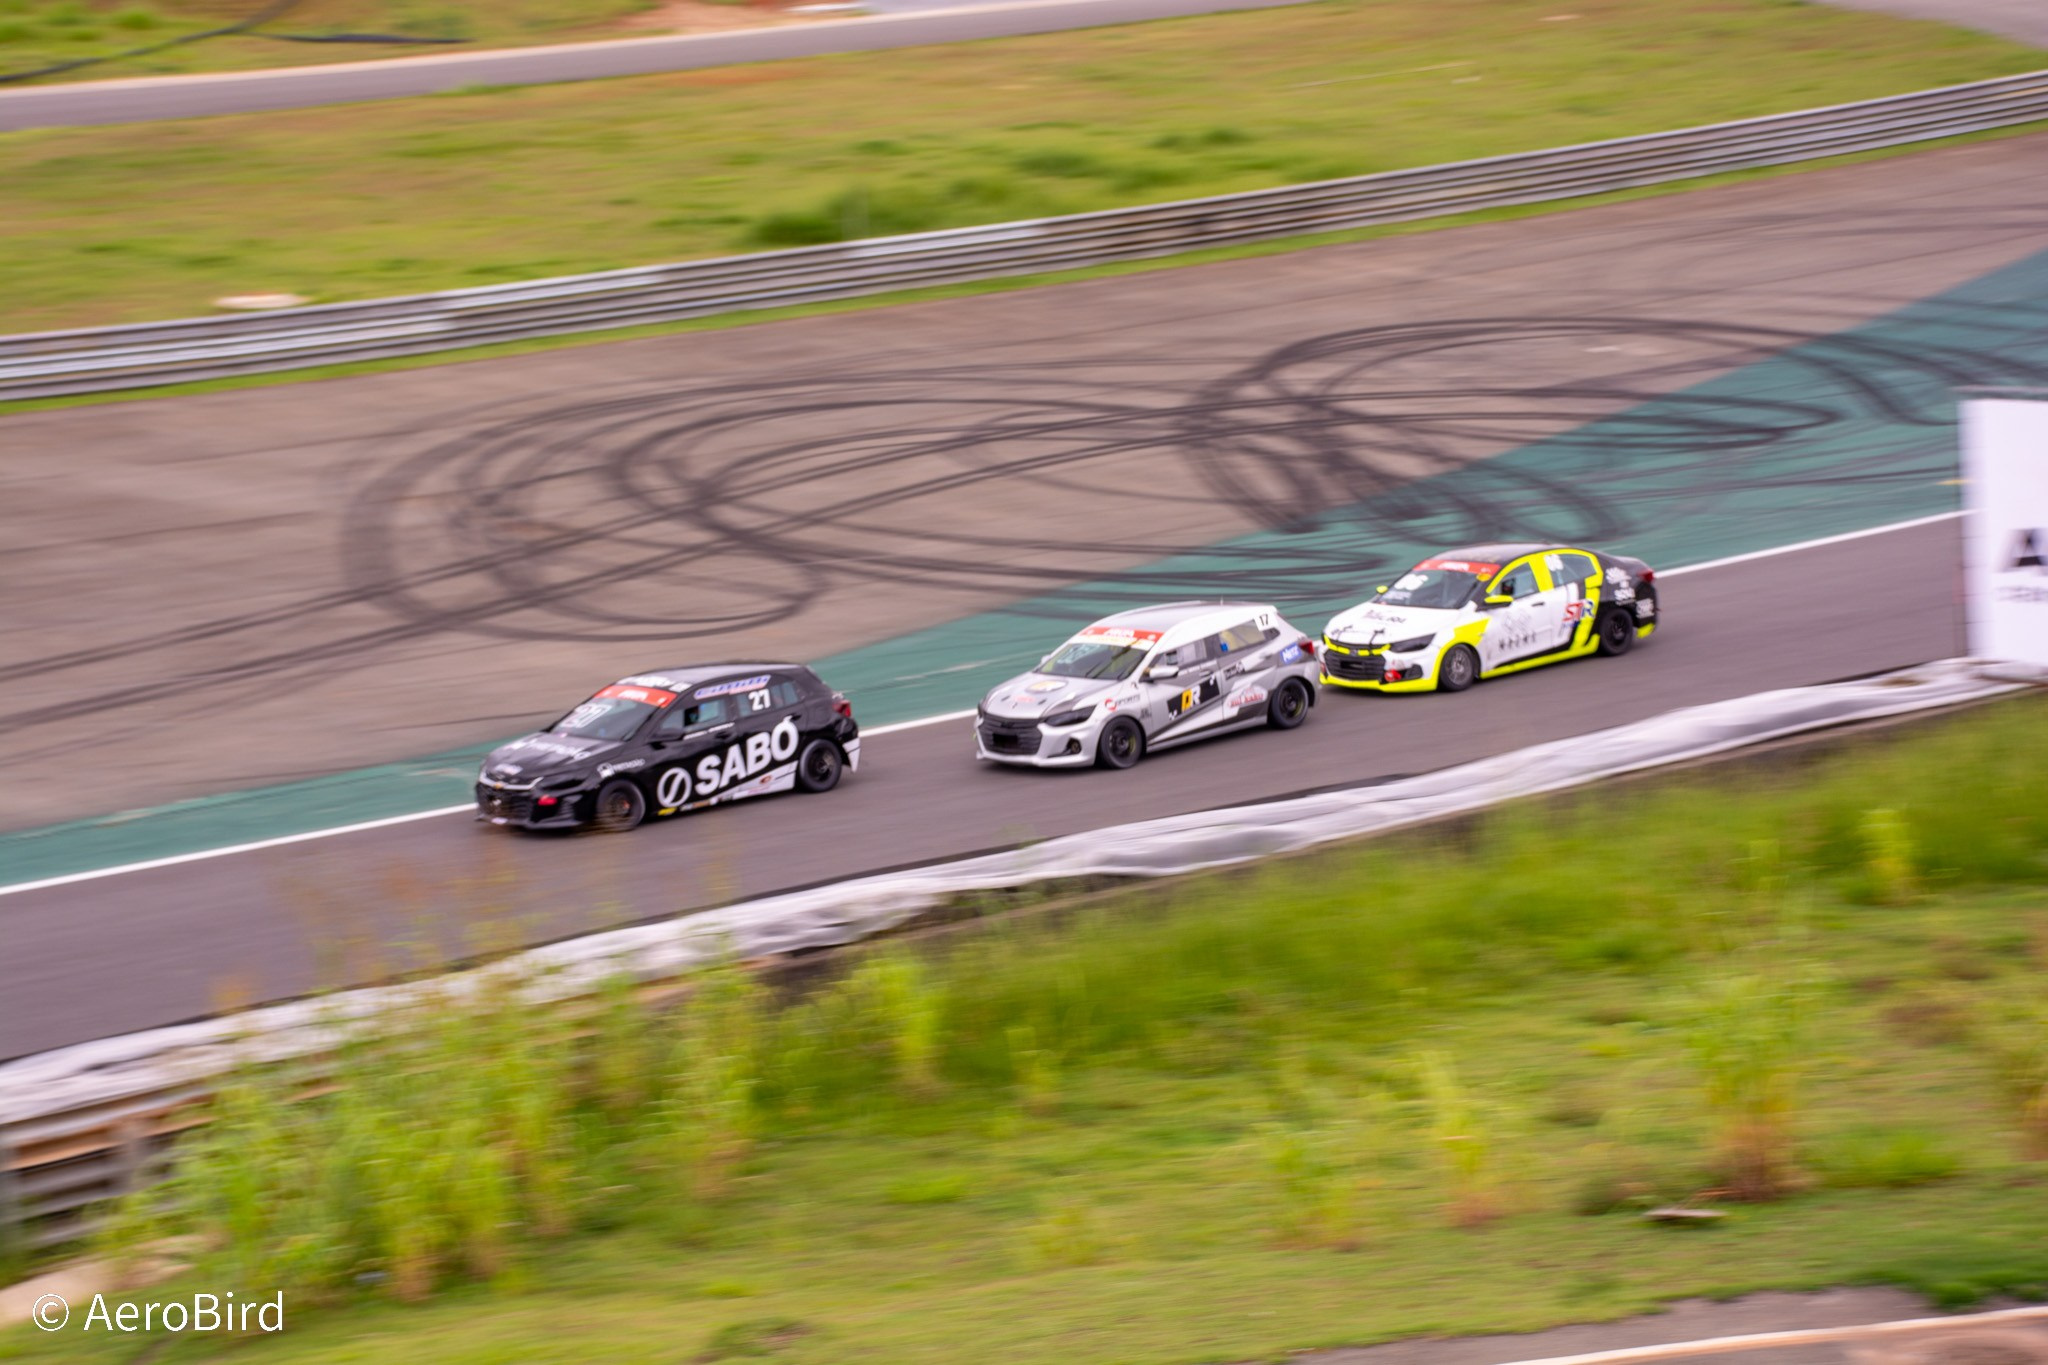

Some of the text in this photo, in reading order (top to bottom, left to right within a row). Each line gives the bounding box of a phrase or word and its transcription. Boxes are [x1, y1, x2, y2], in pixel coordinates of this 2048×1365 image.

[1258, 613, 1269, 627] 17
[748, 688, 771, 711] 27
[694, 715, 799, 795] SABÓ
